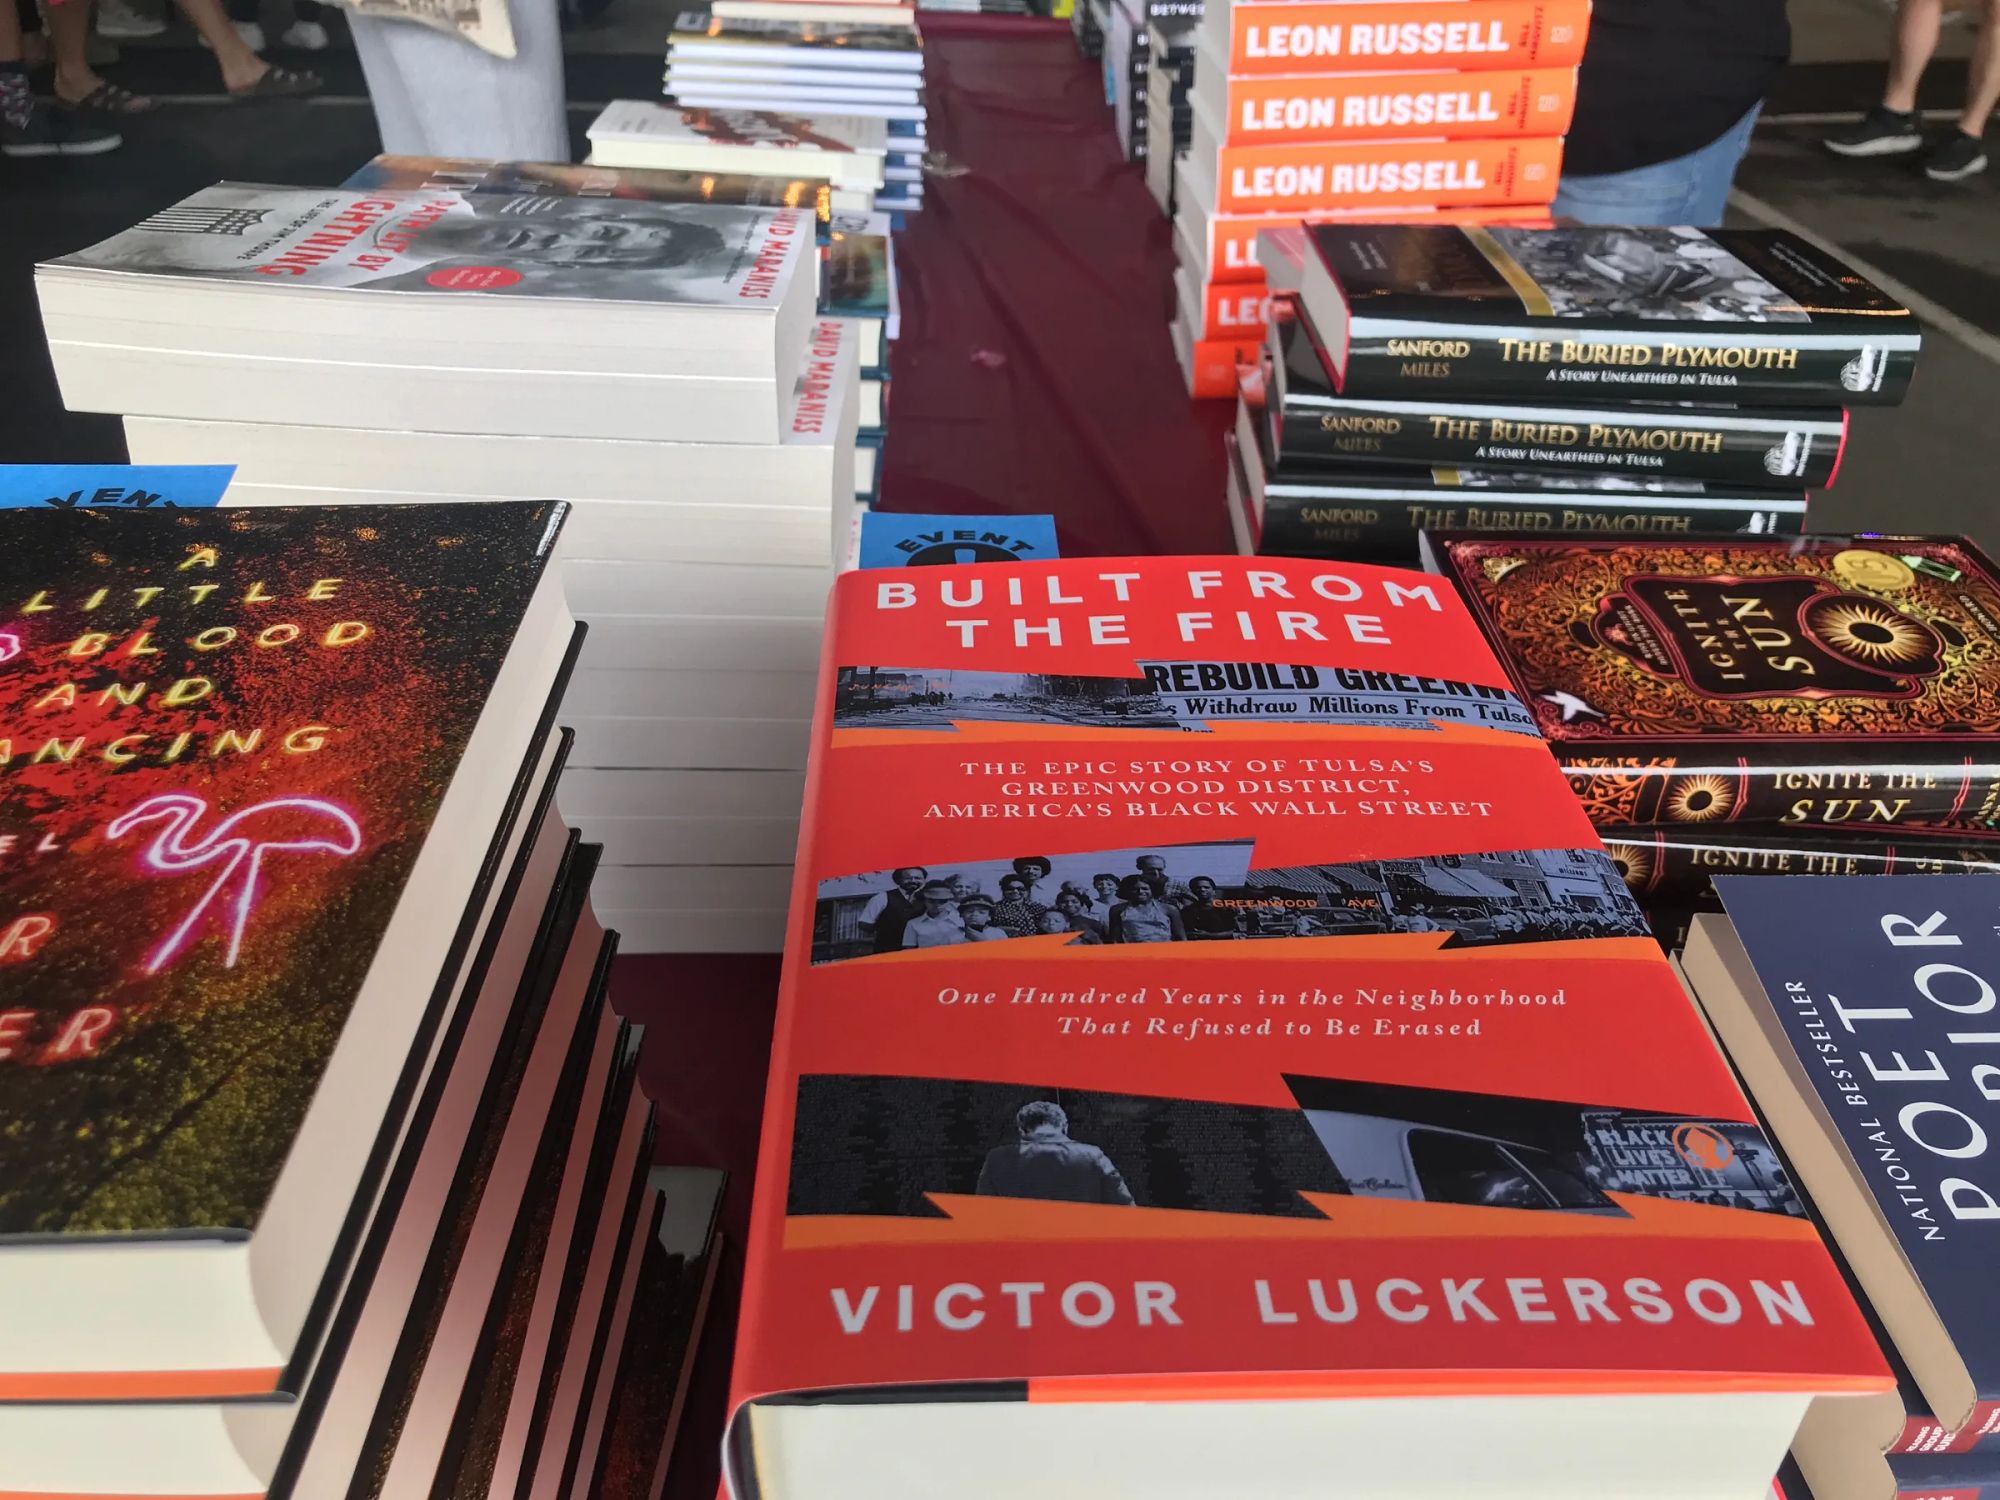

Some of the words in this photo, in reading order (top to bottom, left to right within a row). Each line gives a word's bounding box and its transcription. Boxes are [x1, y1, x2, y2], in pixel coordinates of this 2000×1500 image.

[1246, 25, 1341, 58] LEON
[1349, 21, 1510, 55] RUSSELL
[1242, 96, 1336, 131] LEON
[1343, 91, 1499, 126] RUSSELL
[1232, 165, 1324, 198] LEON
[1331, 160, 1485, 193] RUSSELL
[373, 231, 418, 254] LIT
[348, 253, 395, 272] BY
[739, 239, 790, 299] MARANISS
[812, 322, 843, 357] DAVID
[1386, 338, 1471, 359] SANFORD
[1498, 338, 1552, 363] THE
[1561, 340, 1653, 367] BURIED
[1660, 343, 1798, 369] PLYMOUTH
[1400, 361, 1450, 378] MILES
[1545, 369, 1556, 381] A
[1558, 369, 1599, 382] STORY
[1601, 370, 1678, 385] UNEARTHED
[1680, 373, 1696, 385] IN
[1699, 372, 1738, 386] TULSA
[792, 361, 835, 433] MARANISS
[1321, 414, 1401, 434] SANFORD
[1429, 415, 1480, 441] THE
[1491, 419, 1579, 446] BURIED
[1587, 424, 1724, 454] PLYMOUTH
[1333, 437, 1382, 450] MILES
[1475, 446, 1485, 458] A
[1487, 446, 1527, 460] STORY
[1530, 448, 1605, 463] UNEARTHED
[1607, 453, 1622, 465] IN
[1626, 452, 1664, 467] TULSA
[1301, 507, 1379, 525] SANFORD
[1406, 506, 1456, 529] THE
[1467, 507, 1551, 529] BURIED
[1563, 510, 1692, 532] PLYMOUTH
[896, 530, 1035, 553] EVENT
[178, 547, 220, 572] A
[21, 579, 346, 614] LITTLE
[877, 573, 1142, 609] BUILT
[1187, 571, 1443, 612] FROM
[68, 621, 375, 657] BLOOD
[945, 615, 1131, 648] THE
[1177, 611, 1392, 645] FIRE
[1665, 588, 1746, 680] IGNITE
[1716, 617, 1747, 650] THE
[1720, 594, 1816, 676] SUN
[34, 677, 216, 708] AND
[1144, 663, 1319, 696] REBUILD
[1335, 667, 1521, 702] GREENW
[1185, 696, 1298, 716] Withdraw
[1308, 696, 1400, 716] Millions
[1404, 699, 1466, 719] From
[960, 762, 1027, 777] THE
[1042, 761, 1118, 777] EPIC
[1130, 760, 1236, 776] STORY
[1246, 759, 1289, 774] OF
[1298, 759, 1435, 775] TULSA'S
[1773, 772, 1872, 789] IGNITE
[1885, 771, 1937, 789] THE
[1001, 780, 1226, 797] GREENWOOD
[1237, 779, 1412, 798] DISTRICT,
[923, 802, 1114, 820] AMERICA'S
[1126, 801, 1240, 818] BLACK
[1249, 801, 1348, 818] WALL
[1358, 801, 1493, 818] STREET
[1777, 799, 1912, 824] SUN
[1690, 849, 1792, 871] IGNITE
[1803, 854, 1859, 874] THE
[1212, 898, 1318, 909] GREENWOOD
[1347, 898, 1379, 909] AVE
[938, 987, 998, 1006] One
[1011, 986, 1148, 1006] Hundred
[1162, 986, 1244, 1006] Years
[1258, 987, 1287, 1005] in
[1298, 988, 1344, 1006] the
[1355, 988, 1567, 1011] Neighborhood
[1058, 1017, 1133, 1036] That
[1146, 1017, 1273, 1041] Refused
[1285, 1019, 1312, 1036] to
[1325, 1018, 1362, 1037] Be
[1373, 1017, 1483, 1037] Erased
[1784, 980, 1869, 1107] BESTSELLER
[1828, 994, 2000, 1220] POET
[1593, 1129, 1674, 1148] BLACK
[1612, 1148, 1677, 1167] LIVES
[1615, 1168, 1695, 1187] MATTER
[1860, 1117, 1946, 1241] NATIONAL
[831, 1281, 1184, 1335] VICTOR
[1254, 1276, 1817, 1328] LUCKERSON
[1919, 1426, 1944, 1452] GROUP
[1933, 1433, 1956, 1452] GUID
